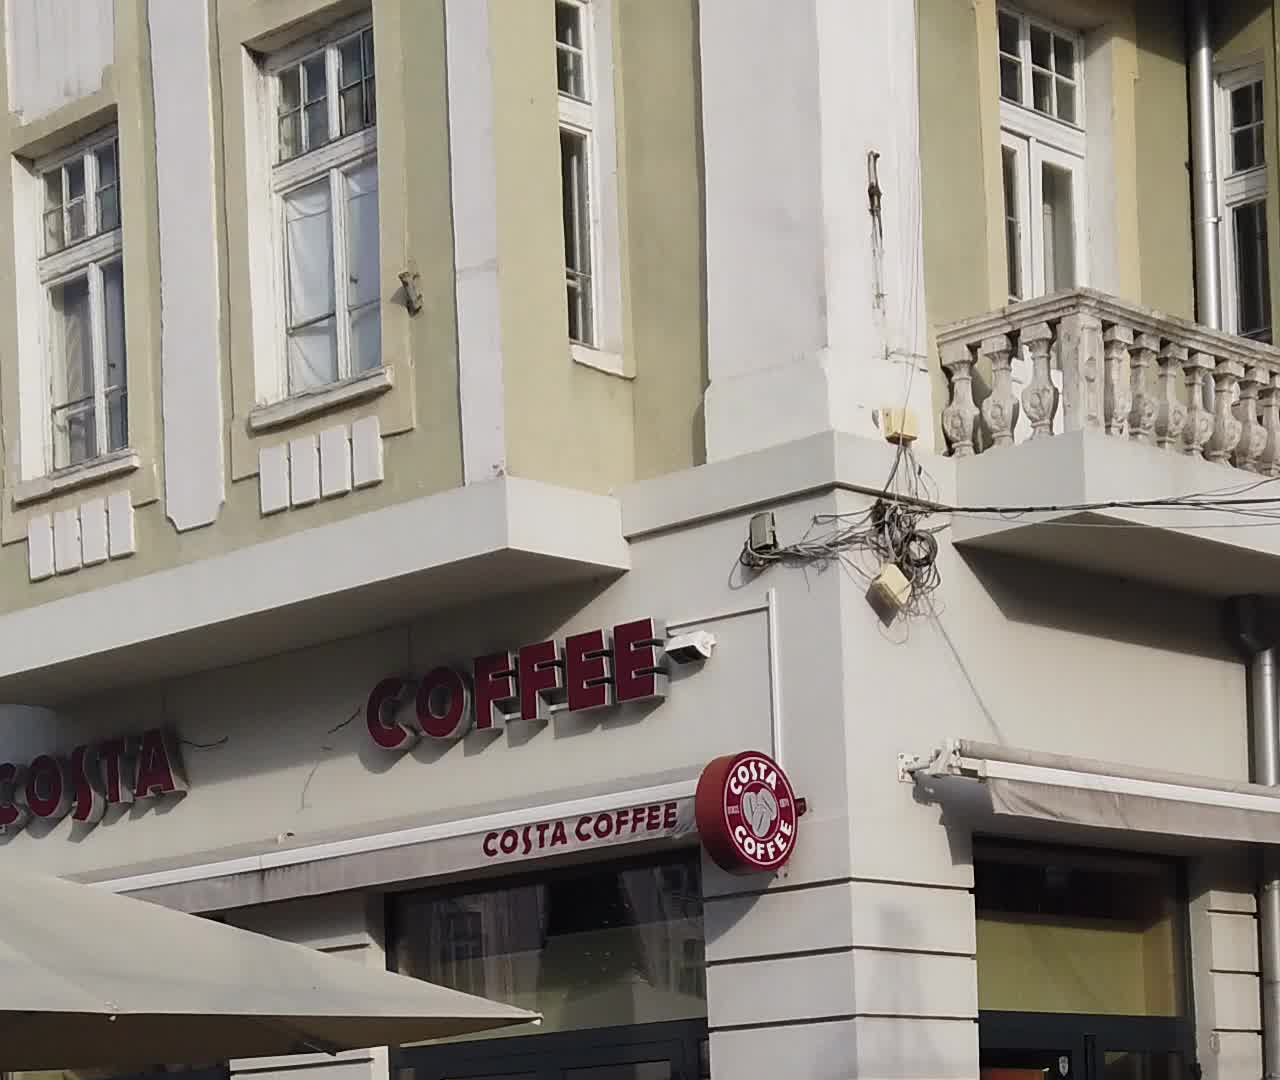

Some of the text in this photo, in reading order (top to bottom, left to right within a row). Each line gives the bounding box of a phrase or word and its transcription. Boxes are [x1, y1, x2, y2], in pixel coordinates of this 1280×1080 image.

[366, 618, 662, 750] COFFEE
[729, 761, 777, 795] COSTA
[483, 802, 677, 857] COSTA COFFEE
[735, 819, 792, 860] COFFEE
